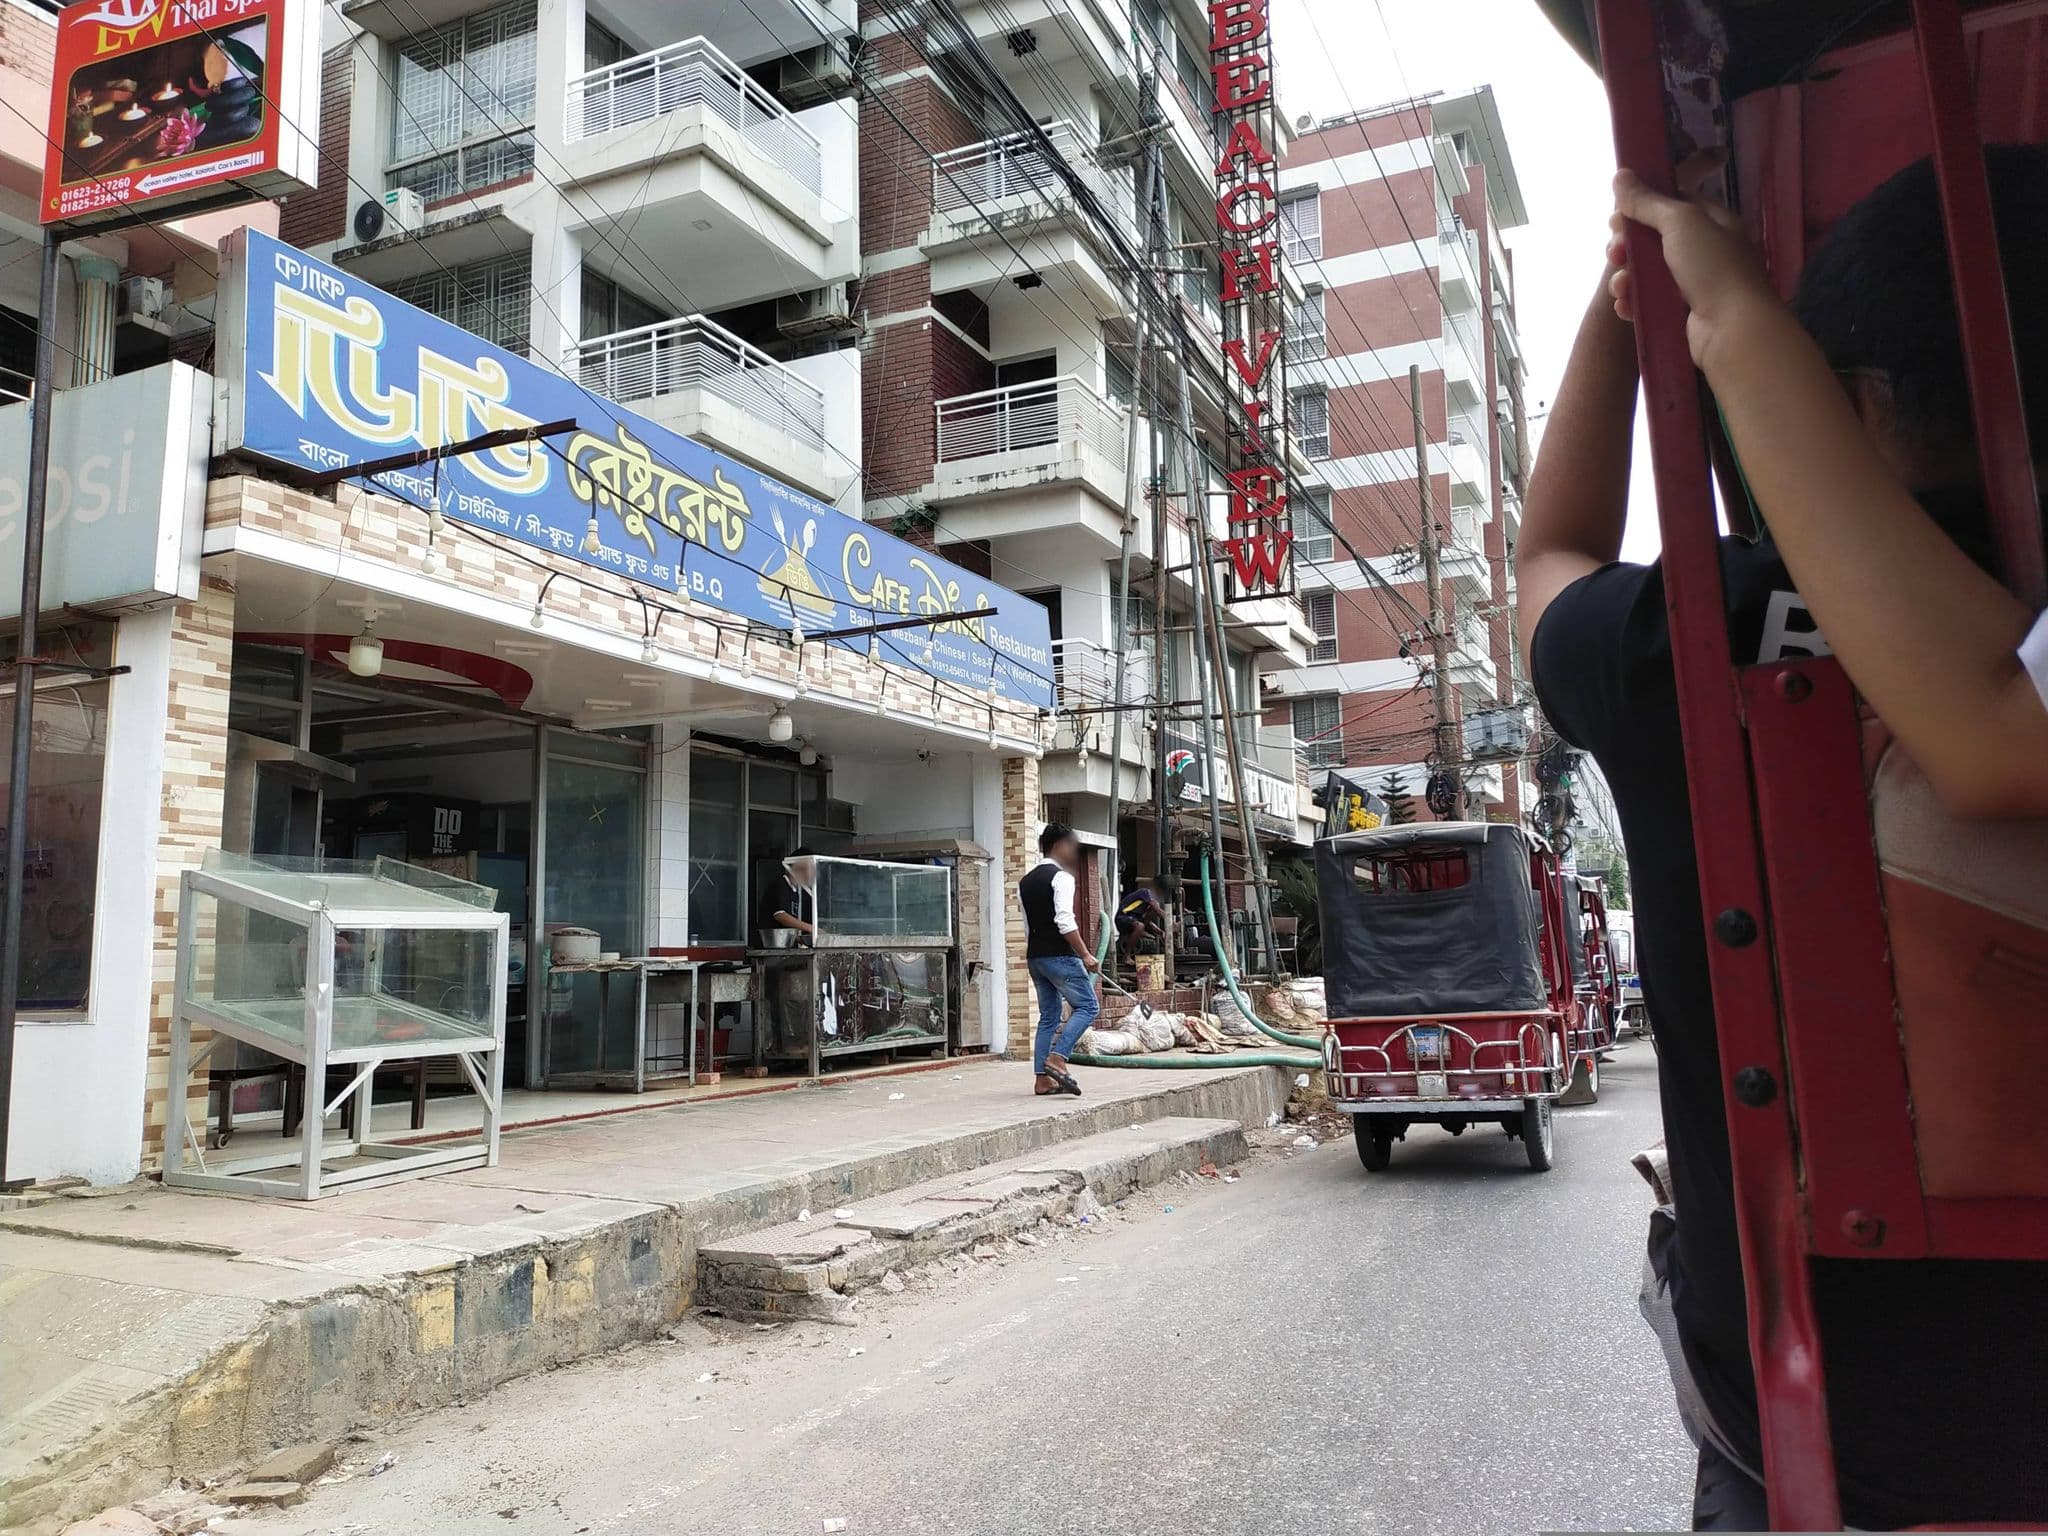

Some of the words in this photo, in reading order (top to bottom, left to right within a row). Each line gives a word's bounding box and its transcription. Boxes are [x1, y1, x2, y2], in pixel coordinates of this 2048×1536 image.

[1207, 0, 1280, 301] BEACH
[274, 251, 345, 300] ক্যাফে
[1221, 331, 1293, 590] VIEW
[298, 437, 350, 468] বাংলা
[458, 494, 511, 527] চাইনিজ
[624, 553, 648, 575] ফুড
[933, 638, 966, 661] Chinese
[989, 625, 1048, 667] Restaurant
[433, 806, 462, 835] DO
[433, 833, 453, 849] THE
